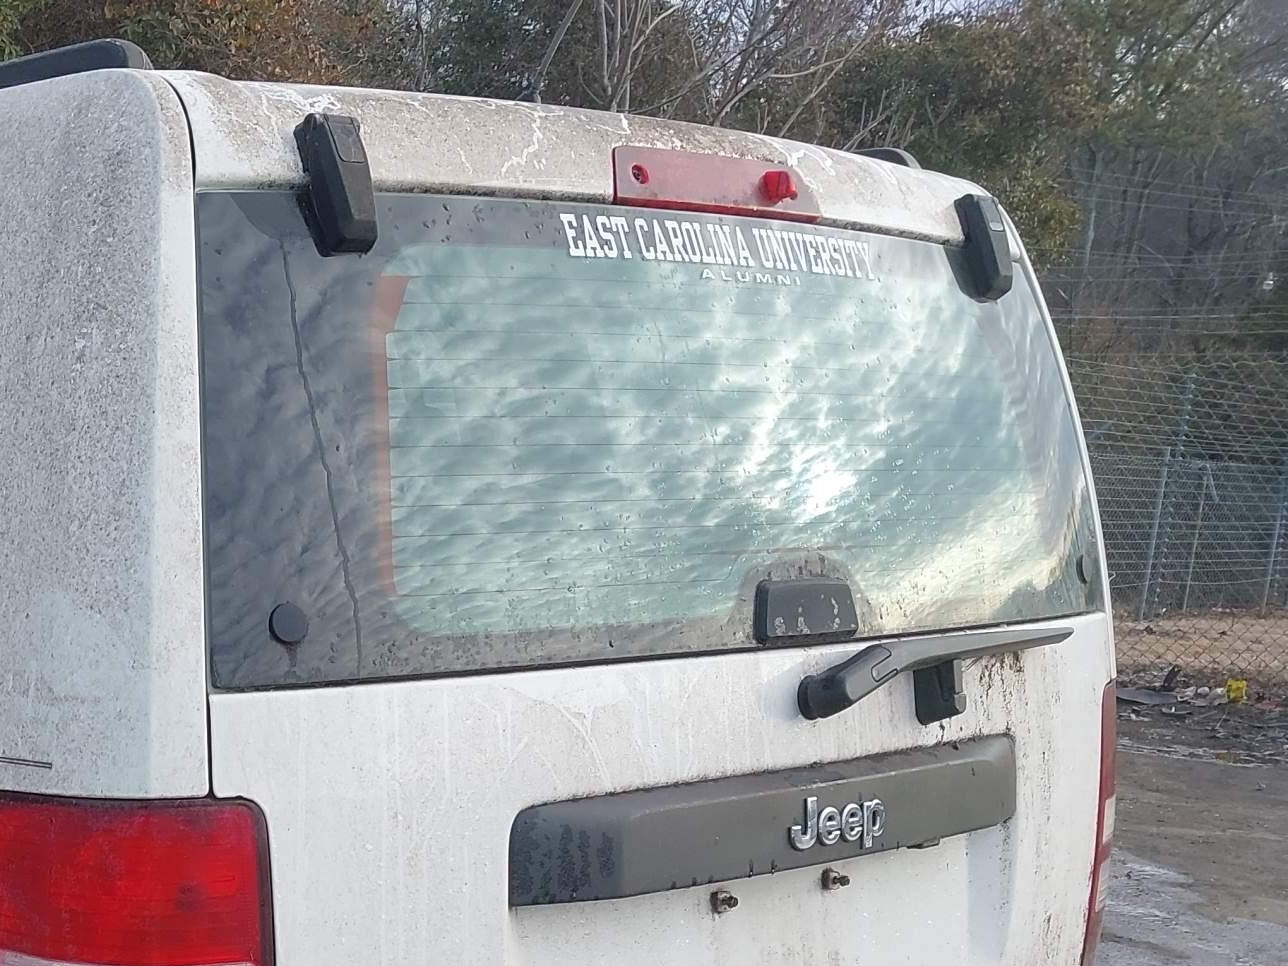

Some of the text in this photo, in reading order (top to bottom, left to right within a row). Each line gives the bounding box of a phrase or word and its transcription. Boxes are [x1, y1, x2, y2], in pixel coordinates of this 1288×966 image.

[559, 213, 876, 280] EAST CAROLINA UNIVERSITY
[701, 268, 801, 286] ALUMNI
[790, 796, 886, 851] Jeep
